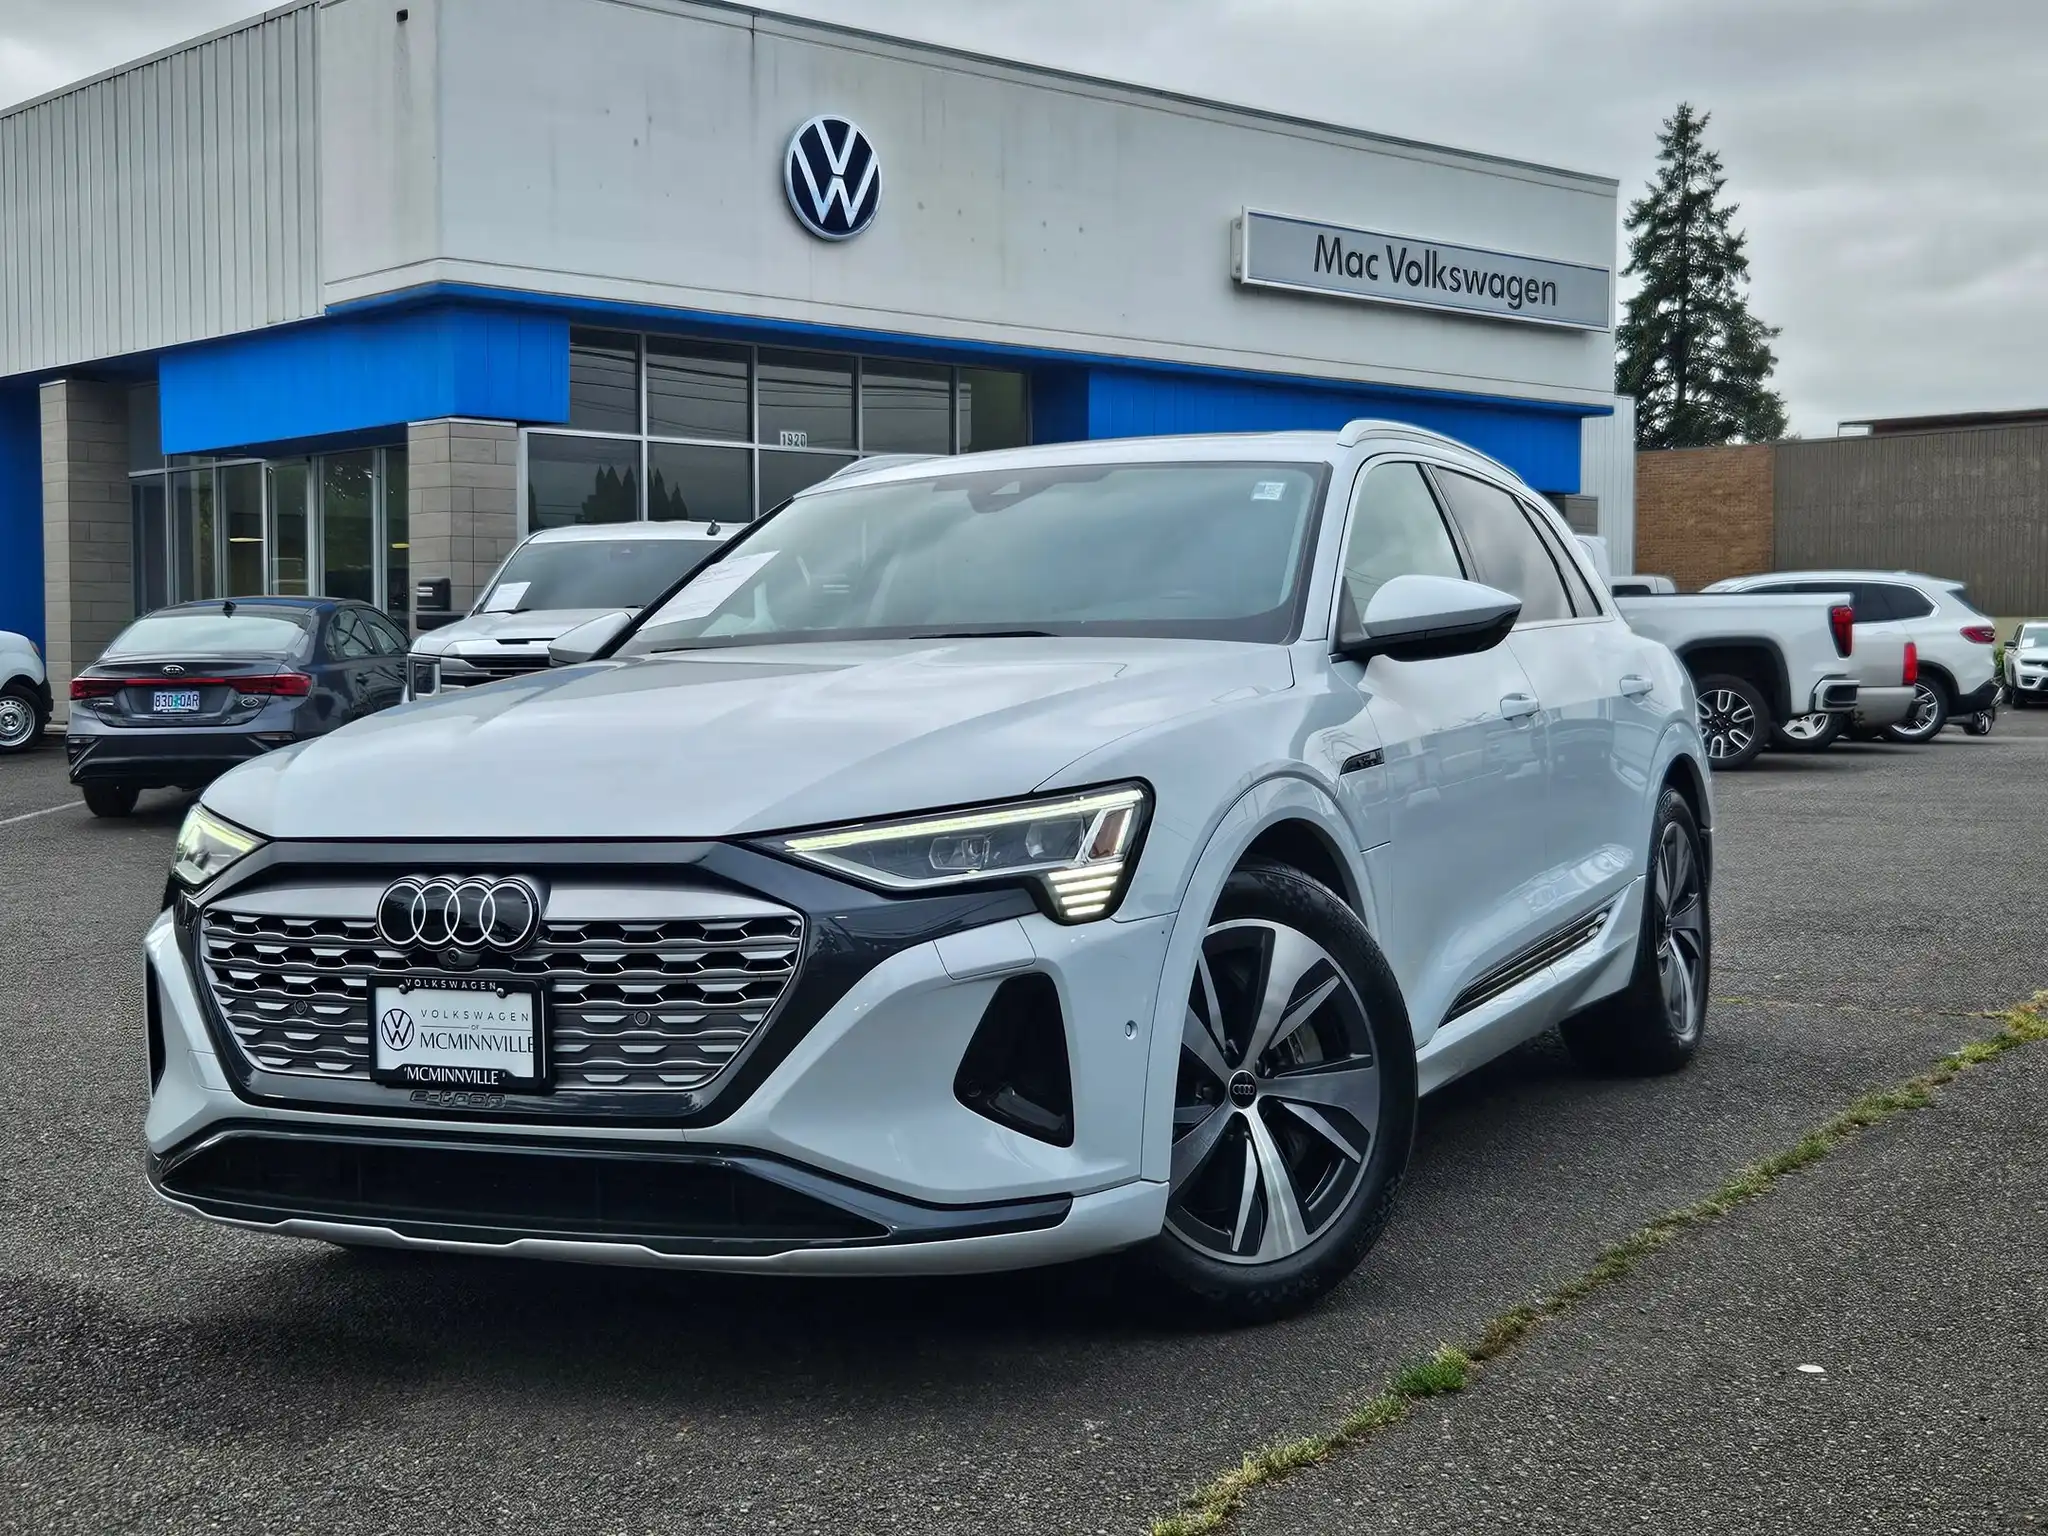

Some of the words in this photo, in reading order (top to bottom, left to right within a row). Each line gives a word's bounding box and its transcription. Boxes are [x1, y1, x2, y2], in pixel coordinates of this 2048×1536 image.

[1313, 234, 1379, 281] Mac
[1385, 244, 1557, 310] Volkswagen
[782, 433, 806, 448] 1920
[405, 978, 496, 990] VOLKSWAGEN
[420, 1009, 529, 1022] VOLKSWAGEN
